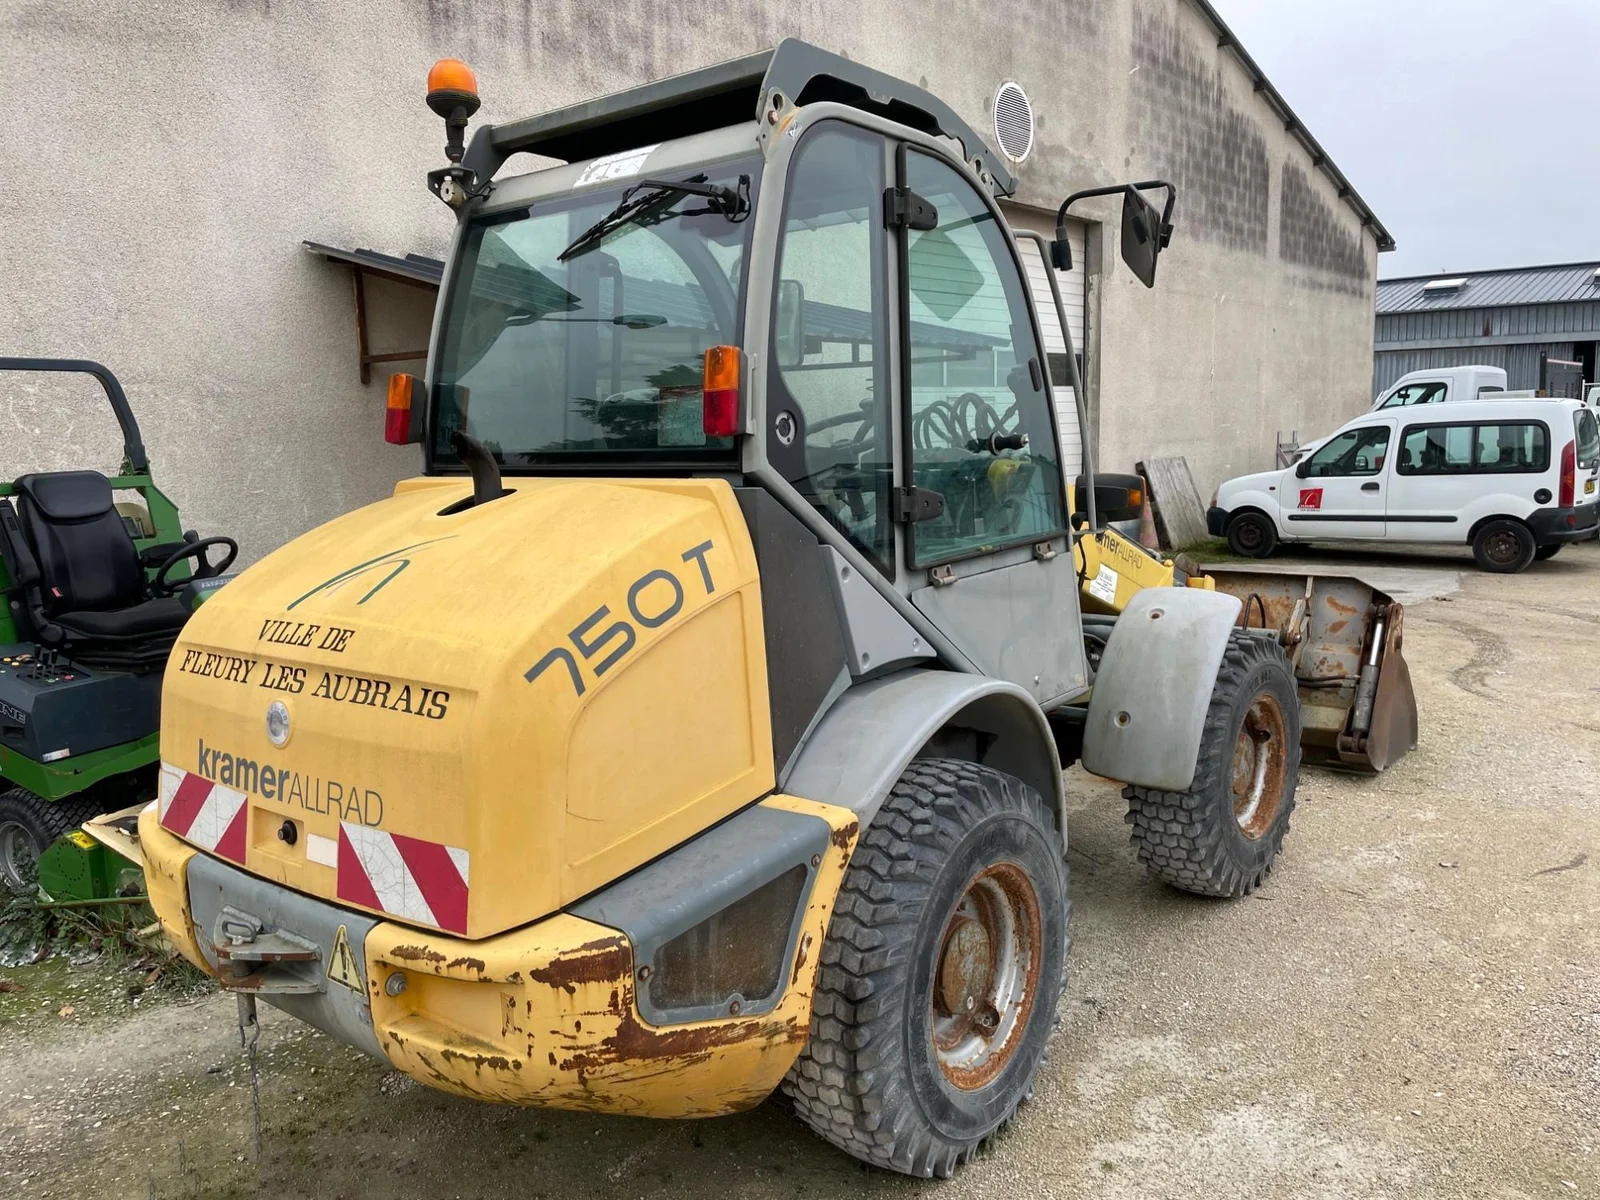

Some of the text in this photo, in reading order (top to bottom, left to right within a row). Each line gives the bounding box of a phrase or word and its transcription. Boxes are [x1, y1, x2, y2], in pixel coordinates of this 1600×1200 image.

[258, 619, 356, 653] VILLE DE
[179, 649, 258, 684] FLEURY
[259, 663, 307, 694] LES
[311, 672, 450, 720] AUBRAIS
